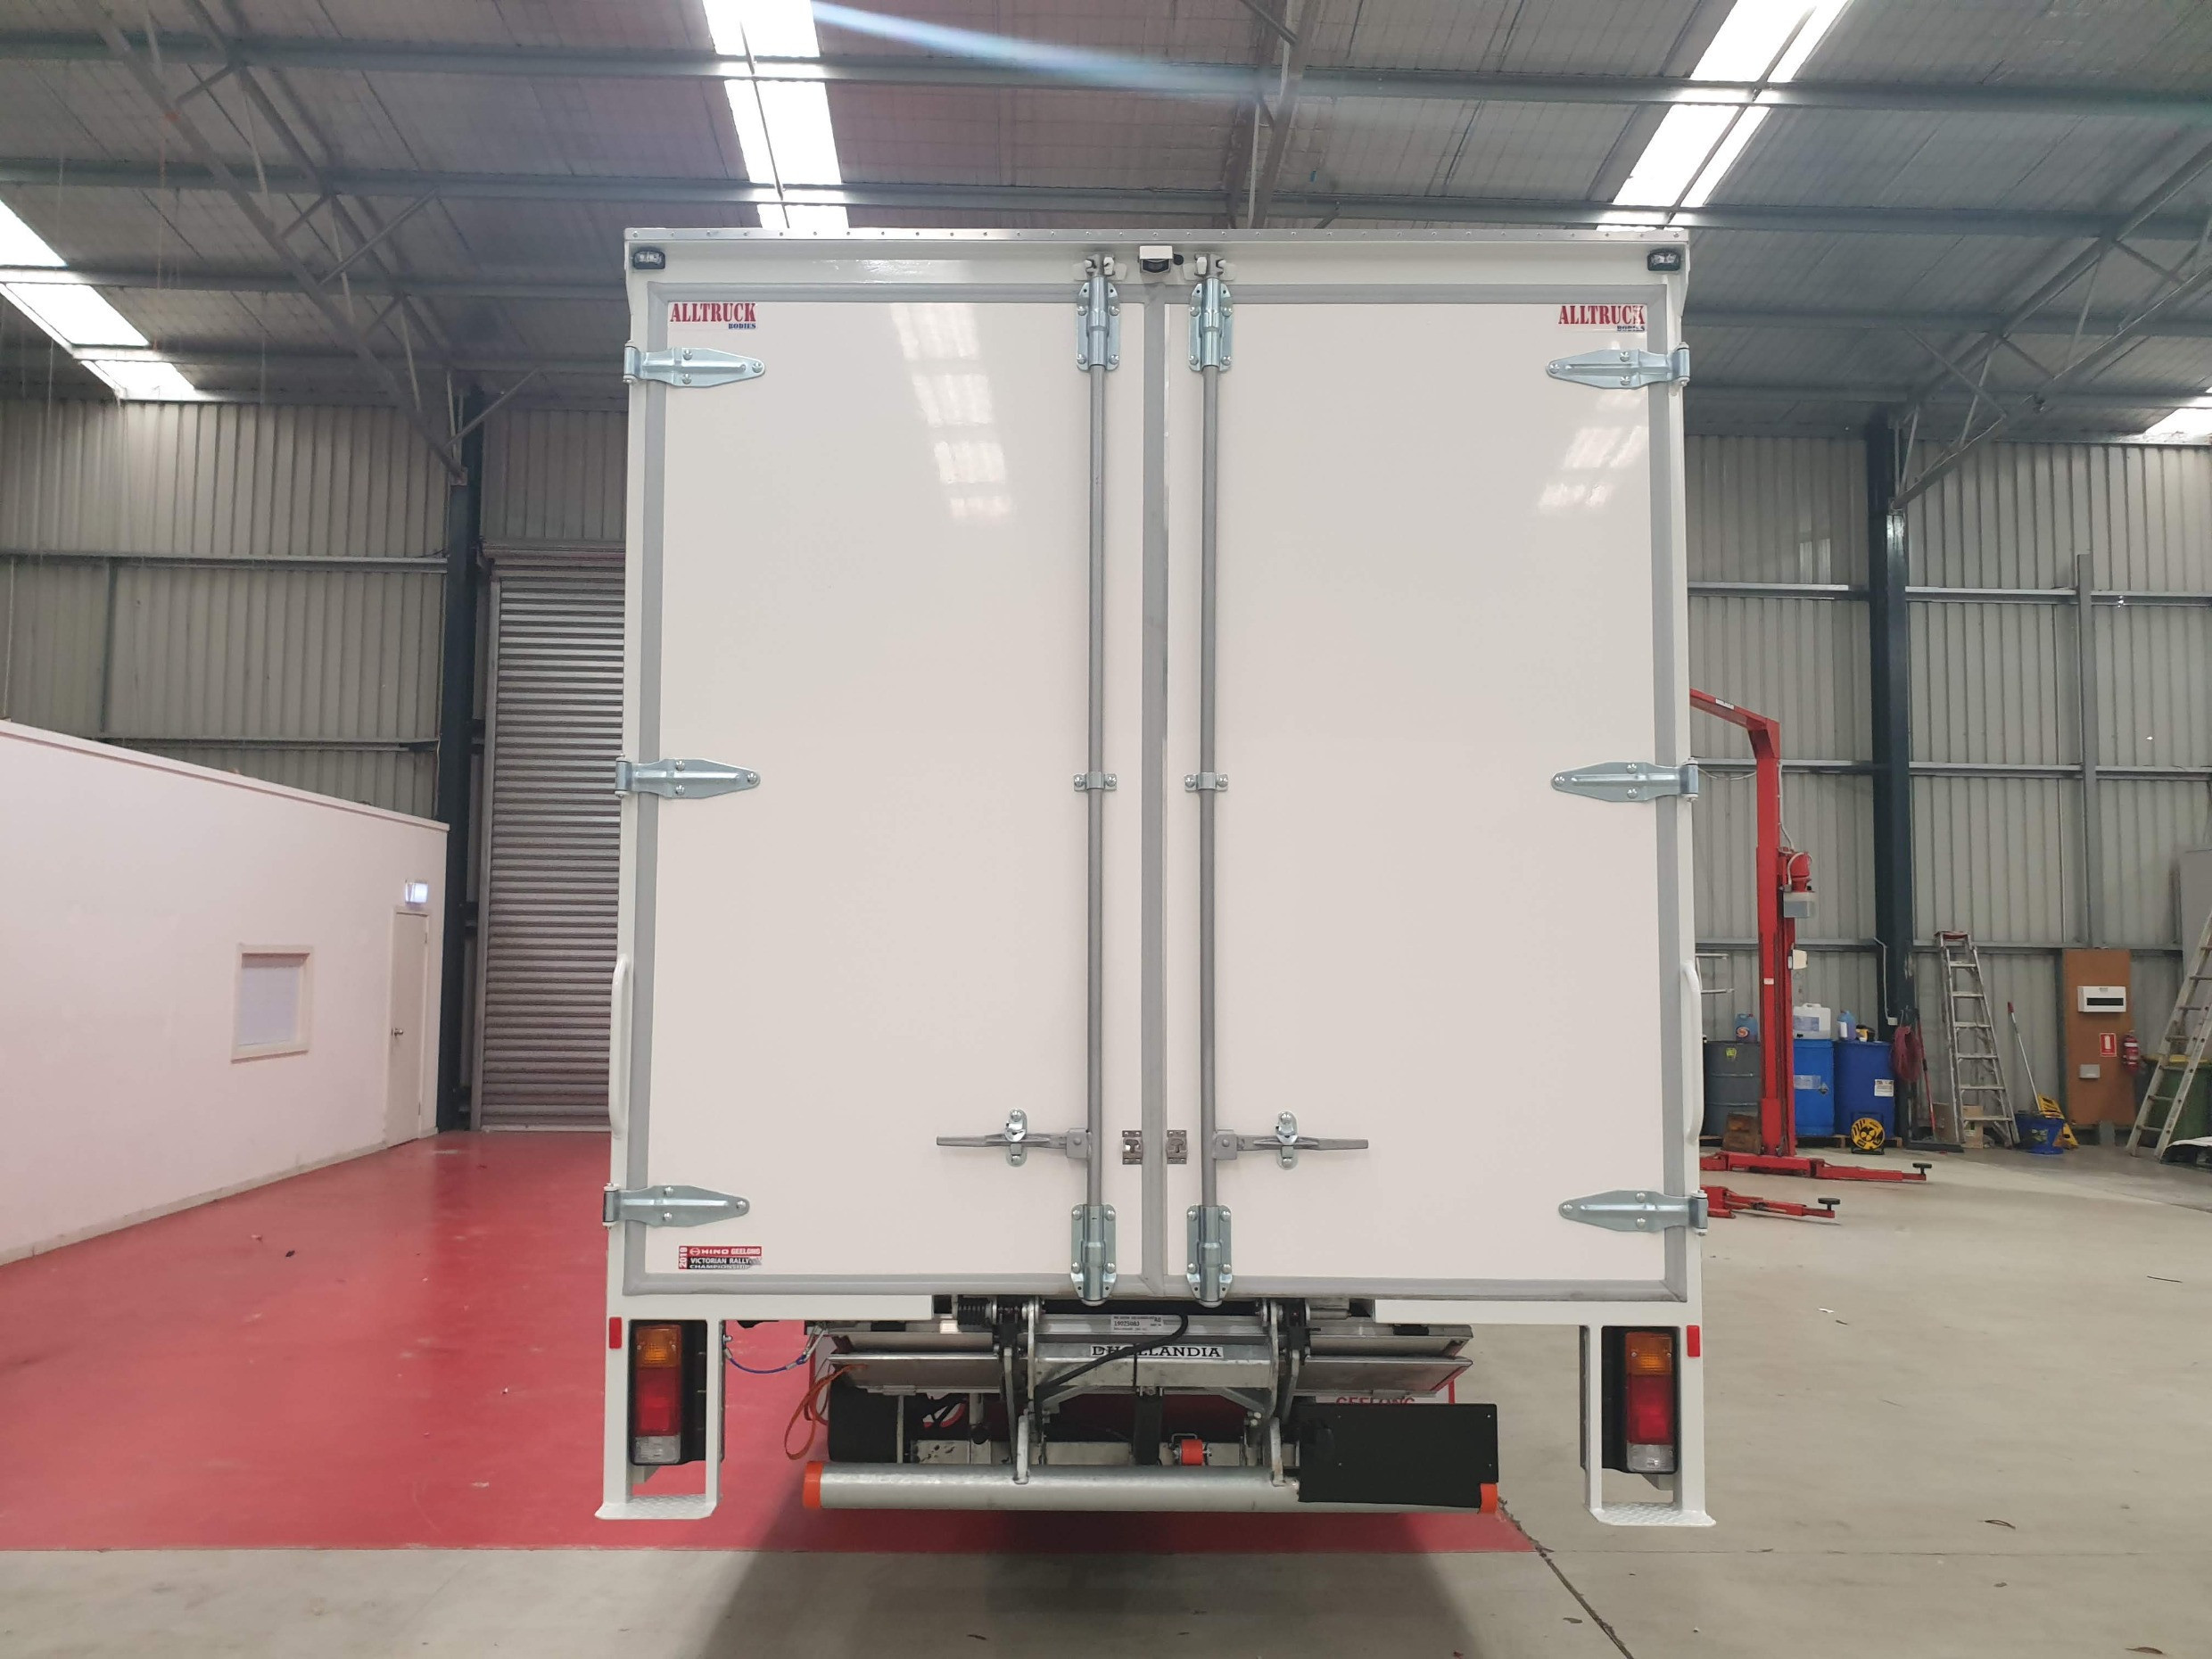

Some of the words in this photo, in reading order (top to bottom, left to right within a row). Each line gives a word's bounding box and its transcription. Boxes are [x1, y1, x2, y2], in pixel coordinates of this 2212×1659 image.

[670, 303, 756, 322] ALLTRUCK
[1558, 305, 1645, 325] ALLTRUCK
[1093, 1346, 1222, 1357] DHLLANDIA
